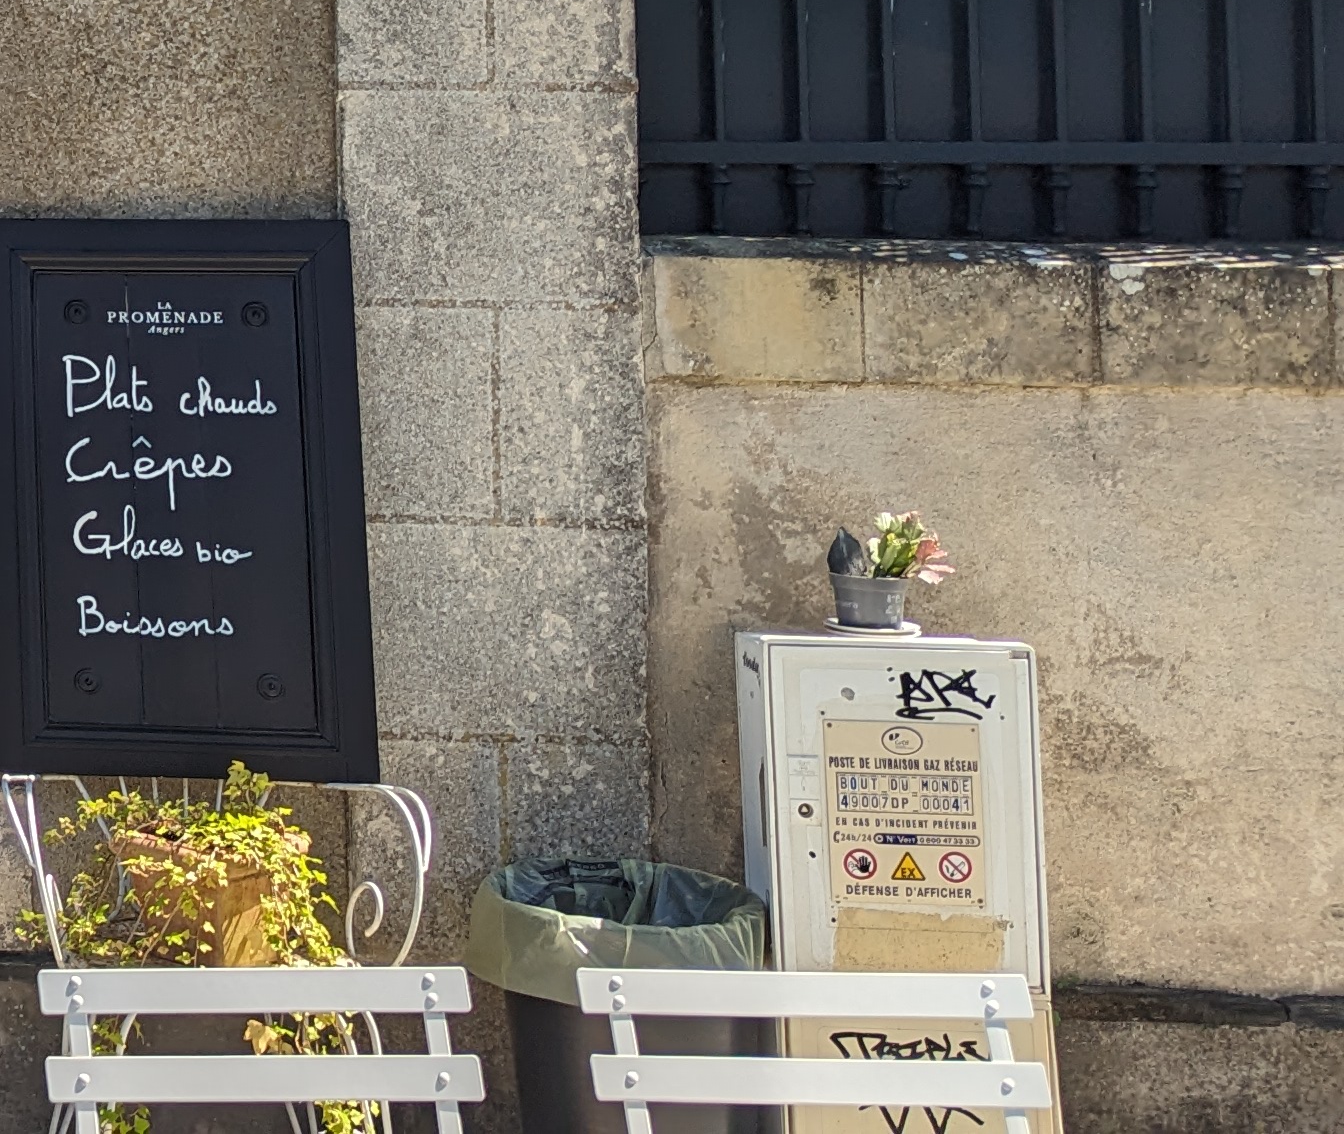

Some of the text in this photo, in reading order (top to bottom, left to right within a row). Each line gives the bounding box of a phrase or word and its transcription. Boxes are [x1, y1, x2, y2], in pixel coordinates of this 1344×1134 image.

[157, 302, 172, 310] LA
[106, 310, 223, 324] PROMENADE
[147, 325, 185, 335] Angers
[62, 354, 277, 417] Plats chauds
[65, 436, 232, 511] Crêpes
[73, 504, 253, 564] Glaces bio
[76, 594, 234, 638] Boissons
[828, 755, 855, 769] POSTE
[859, 757, 871, 770] DE
[874, 757, 920, 771] LIVRAISON
[923, 759, 940, 771] GAZ
[944, 757, 979, 773] RÉSEAU
[839, 776, 970, 793] BOUT DU MONDE
[922, 797, 970, 811] 00041
[835, 817, 978, 830] EN CAS D'INCIDENT PRÉVENIR
[900, 867, 916, 879] EX
[846, 882, 972, 899] DÉFENSE D'AFFICHER
